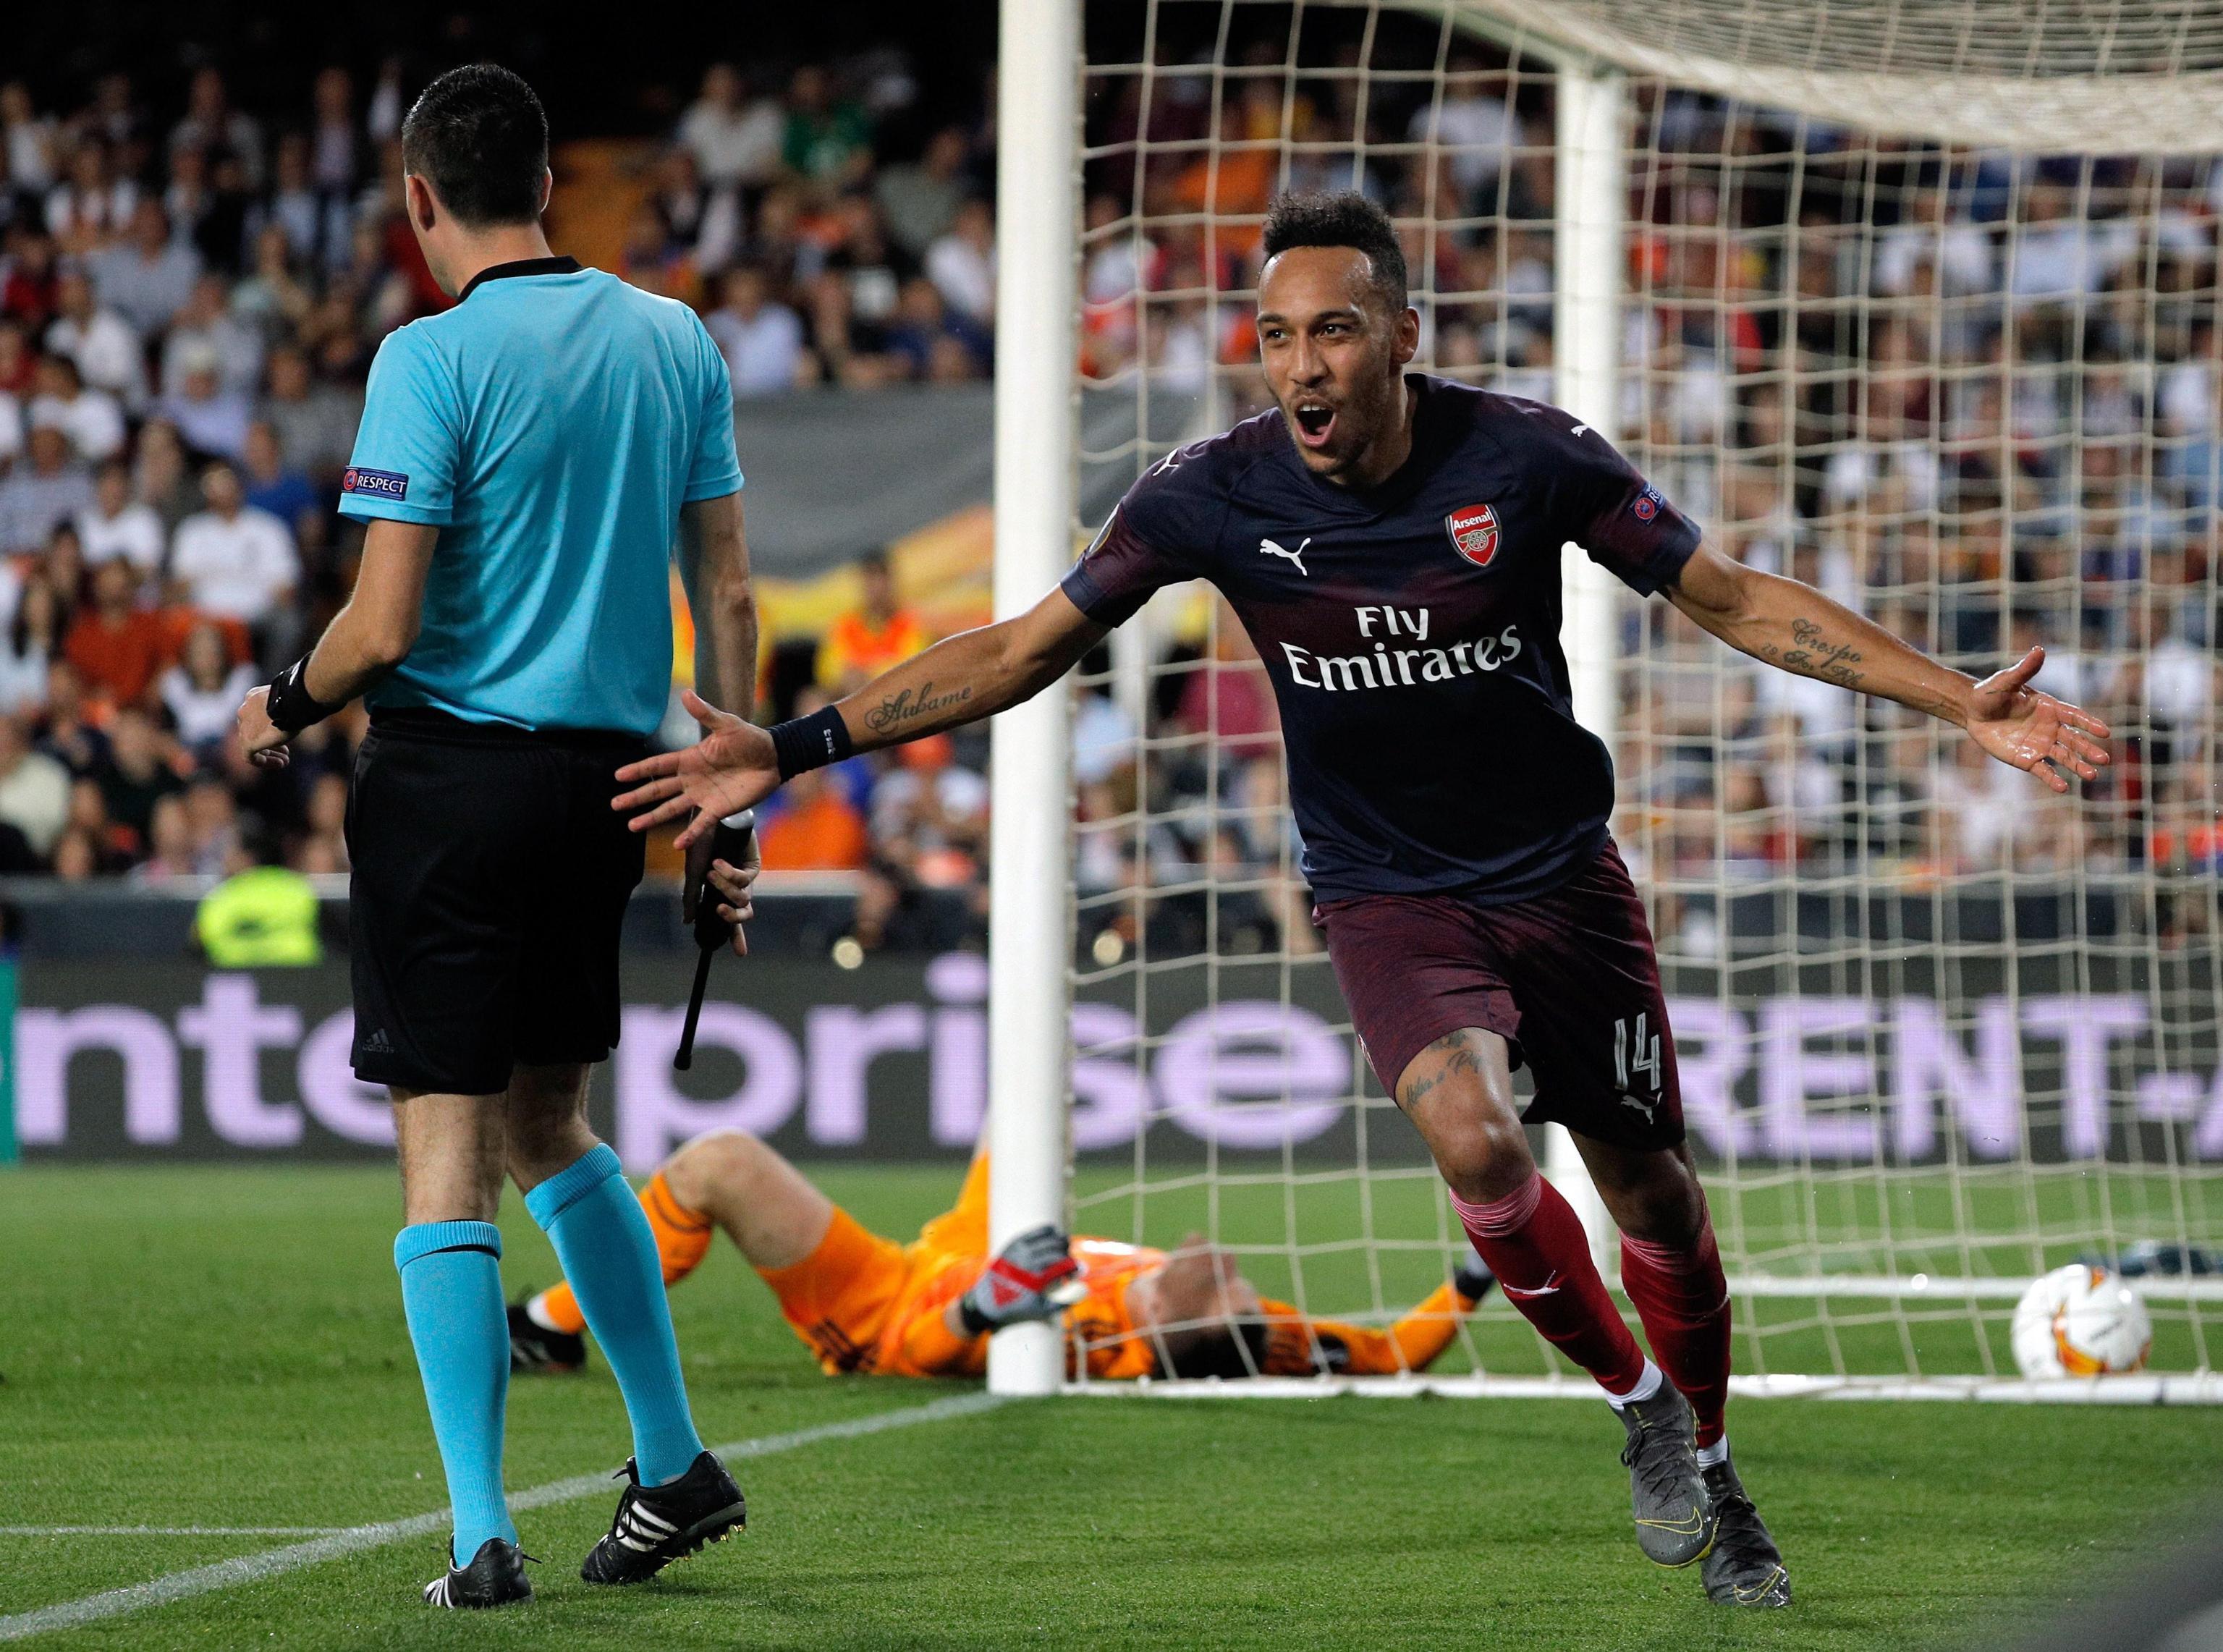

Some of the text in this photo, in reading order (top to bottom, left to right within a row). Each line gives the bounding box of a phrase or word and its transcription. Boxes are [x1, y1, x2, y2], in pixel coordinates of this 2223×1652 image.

[356, 475, 407, 493] RESPECT
[1453, 511, 1491, 530] Arsenal
[1353, 605, 1429, 640] Fly
[1792, 618, 1862, 669] Crespo
[1278, 624, 1522, 691] Emirates
[864, 682, 973, 734] Aubame
[1614, 1012, 1661, 1092] 14
